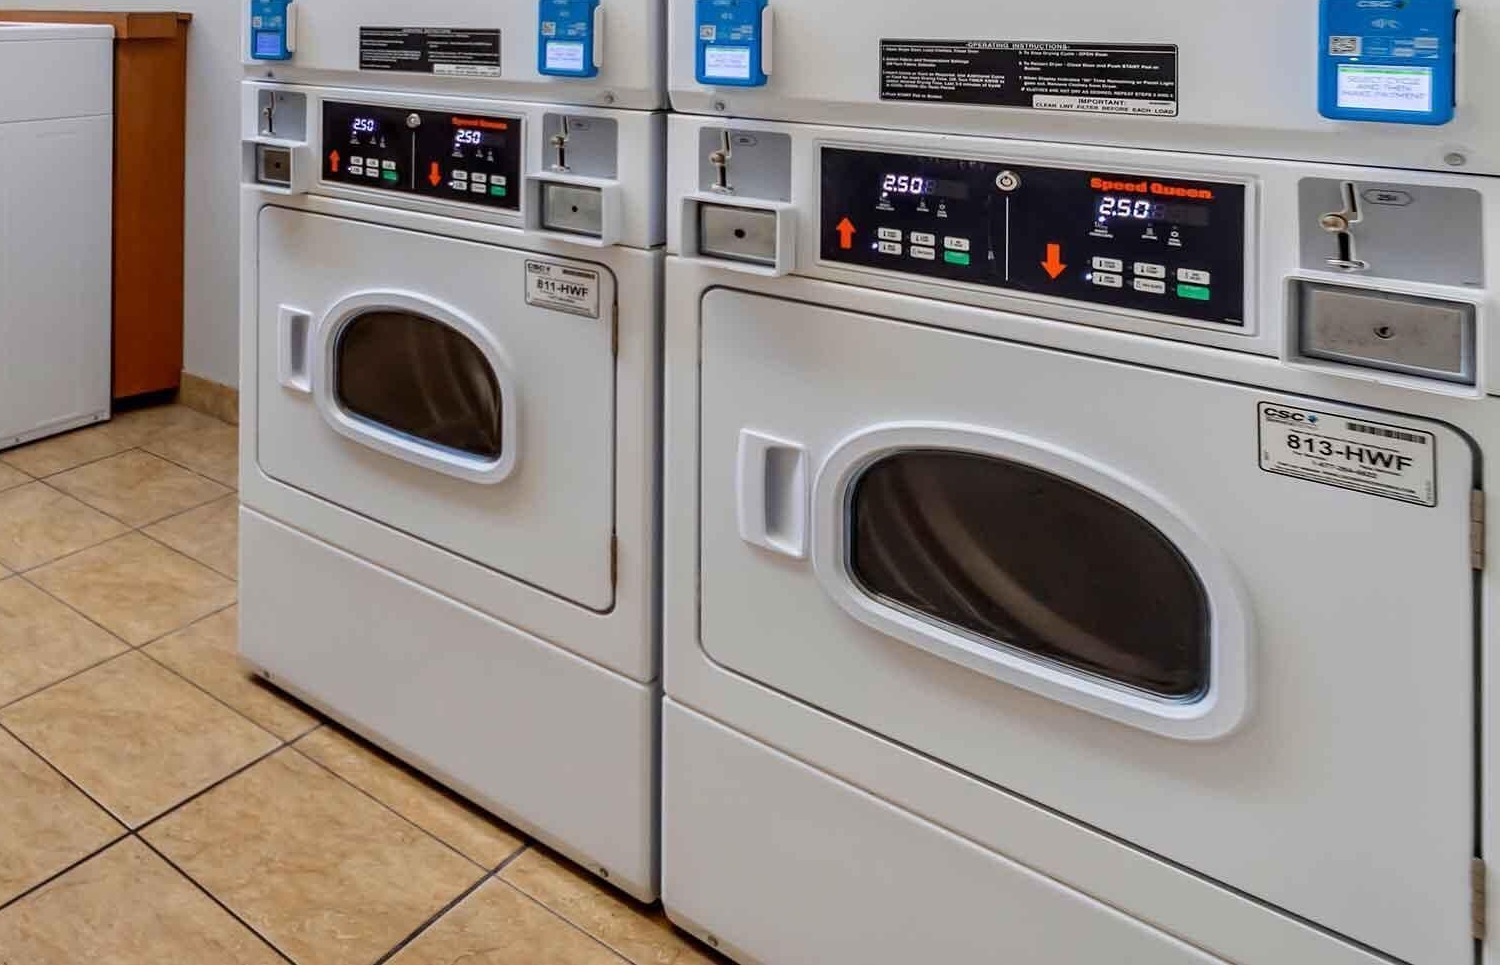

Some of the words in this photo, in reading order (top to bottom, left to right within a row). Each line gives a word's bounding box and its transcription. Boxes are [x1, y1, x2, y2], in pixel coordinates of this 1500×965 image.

[883, 174, 923, 194] 2.50
[1091, 177, 1148, 193] Speed
[1150, 182, 1213, 200] Queen
[1099, 197, 1150, 219] 2.50
[537, 279, 588, 297] 811-HWF
[1264, 407, 1304, 422] CSC
[1287, 434, 1412, 470] 813-HWF
